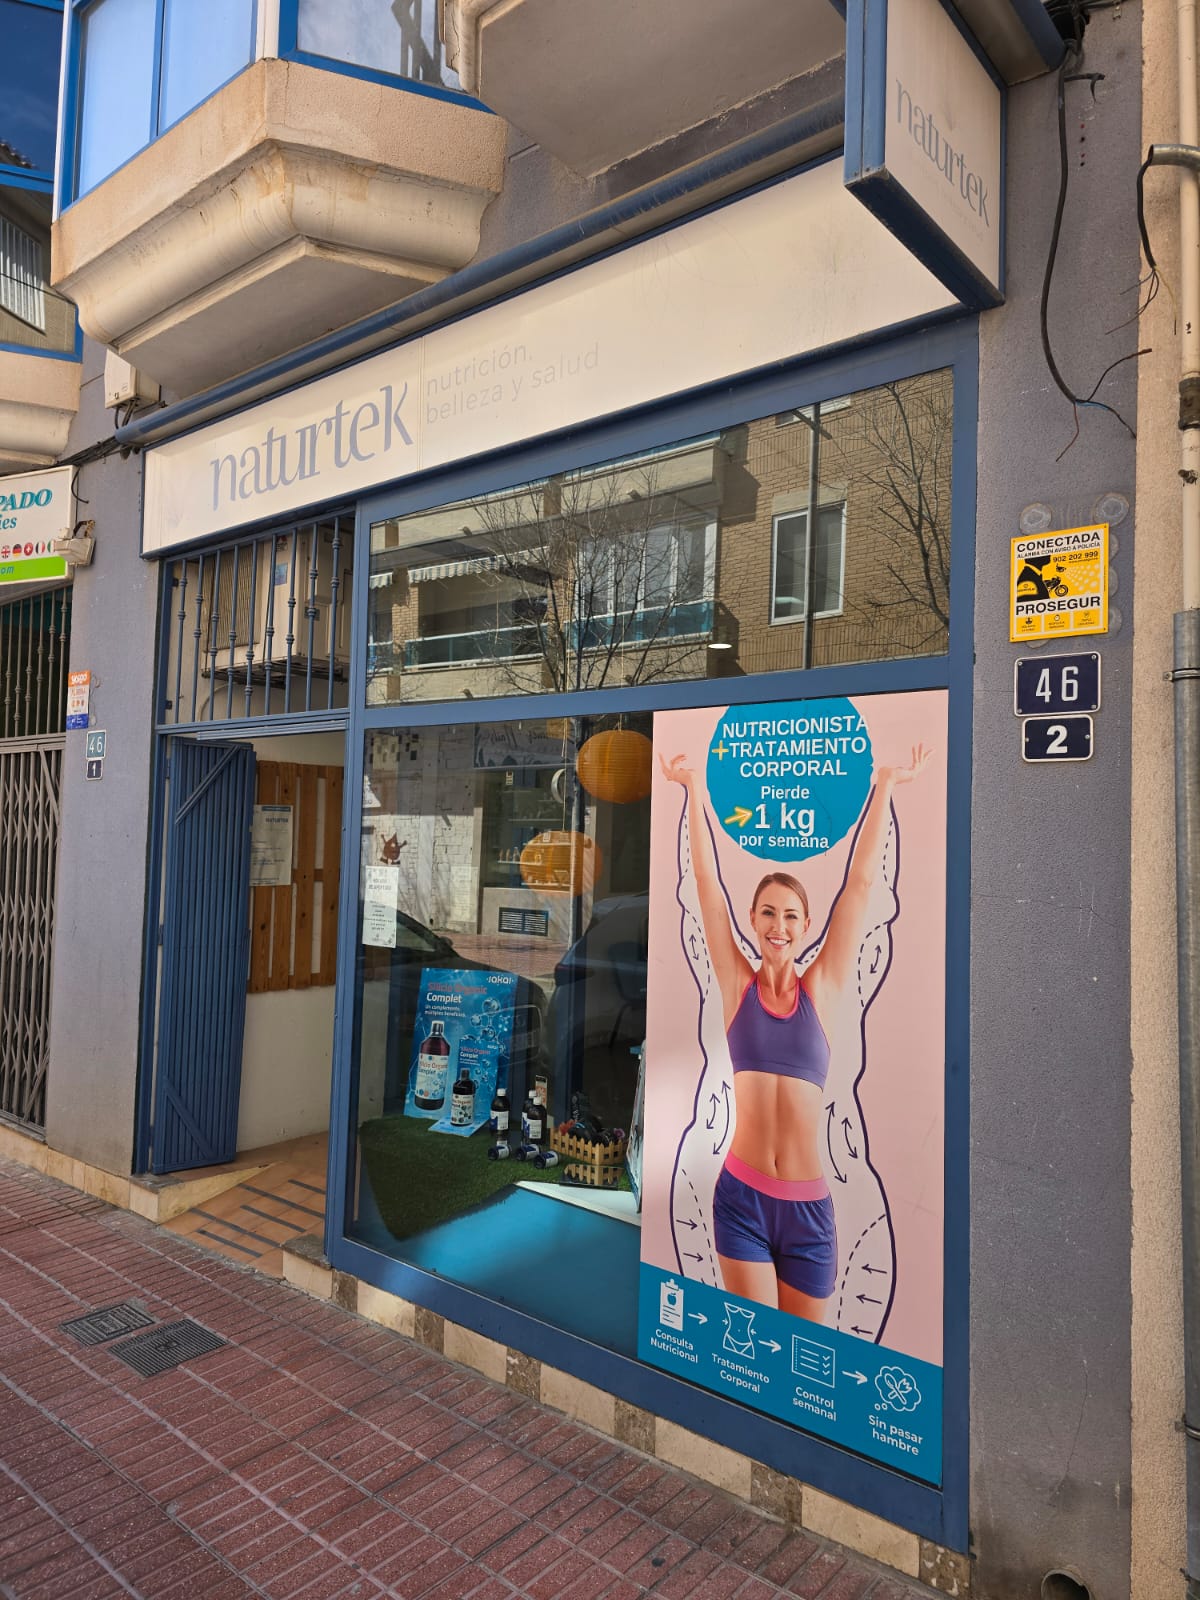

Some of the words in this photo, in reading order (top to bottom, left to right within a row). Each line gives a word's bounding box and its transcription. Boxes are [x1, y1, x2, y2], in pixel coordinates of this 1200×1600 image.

[895, 78, 990, 227] naturtek
[426, 383, 503, 424] belleza
[511, 375, 524, 402] y
[531, 341, 600, 389] salud
[210, 381, 414, 511] naturtek
[1017, 532, 1100, 552] CONECTADA
[1077, 542, 1100, 550] POLICÍA
[1084, 551, 1098, 559] 999
[1016, 596, 1100, 615] PROSEGUR
[1035, 666, 1079, 703] 46
[722, 715, 869, 738] NUTRICIONISTA
[89, 736, 103, 753] 46
[729, 737, 867, 758] TRATAMIENTO
[1046, 725, 1068, 754] 2
[92, 762, 97, 777] 1
[740, 760, 847, 778] CORPORAL
[761, 785, 810, 800] Pierde
[755, 803, 770, 829] 1
[781, 802, 815, 837] kg
[739, 835, 763, 848] por
[768, 836, 829, 849] semana
[426, 992, 462, 1004] Complet
[650, 1337, 698, 1363] Nutricional
[655, 1329, 694, 1351] Consulta
[711, 1353, 770, 1384] Tratamiento
[720, 1370, 761, 1393] Corporal
[795, 1386, 834, 1409] Control
[792, 1397, 837, 1422] semanal
[868, 1415, 887, 1430] Sin
[889, 1424, 923, 1444] pasar
[872, 1428, 919, 1455] hambre
